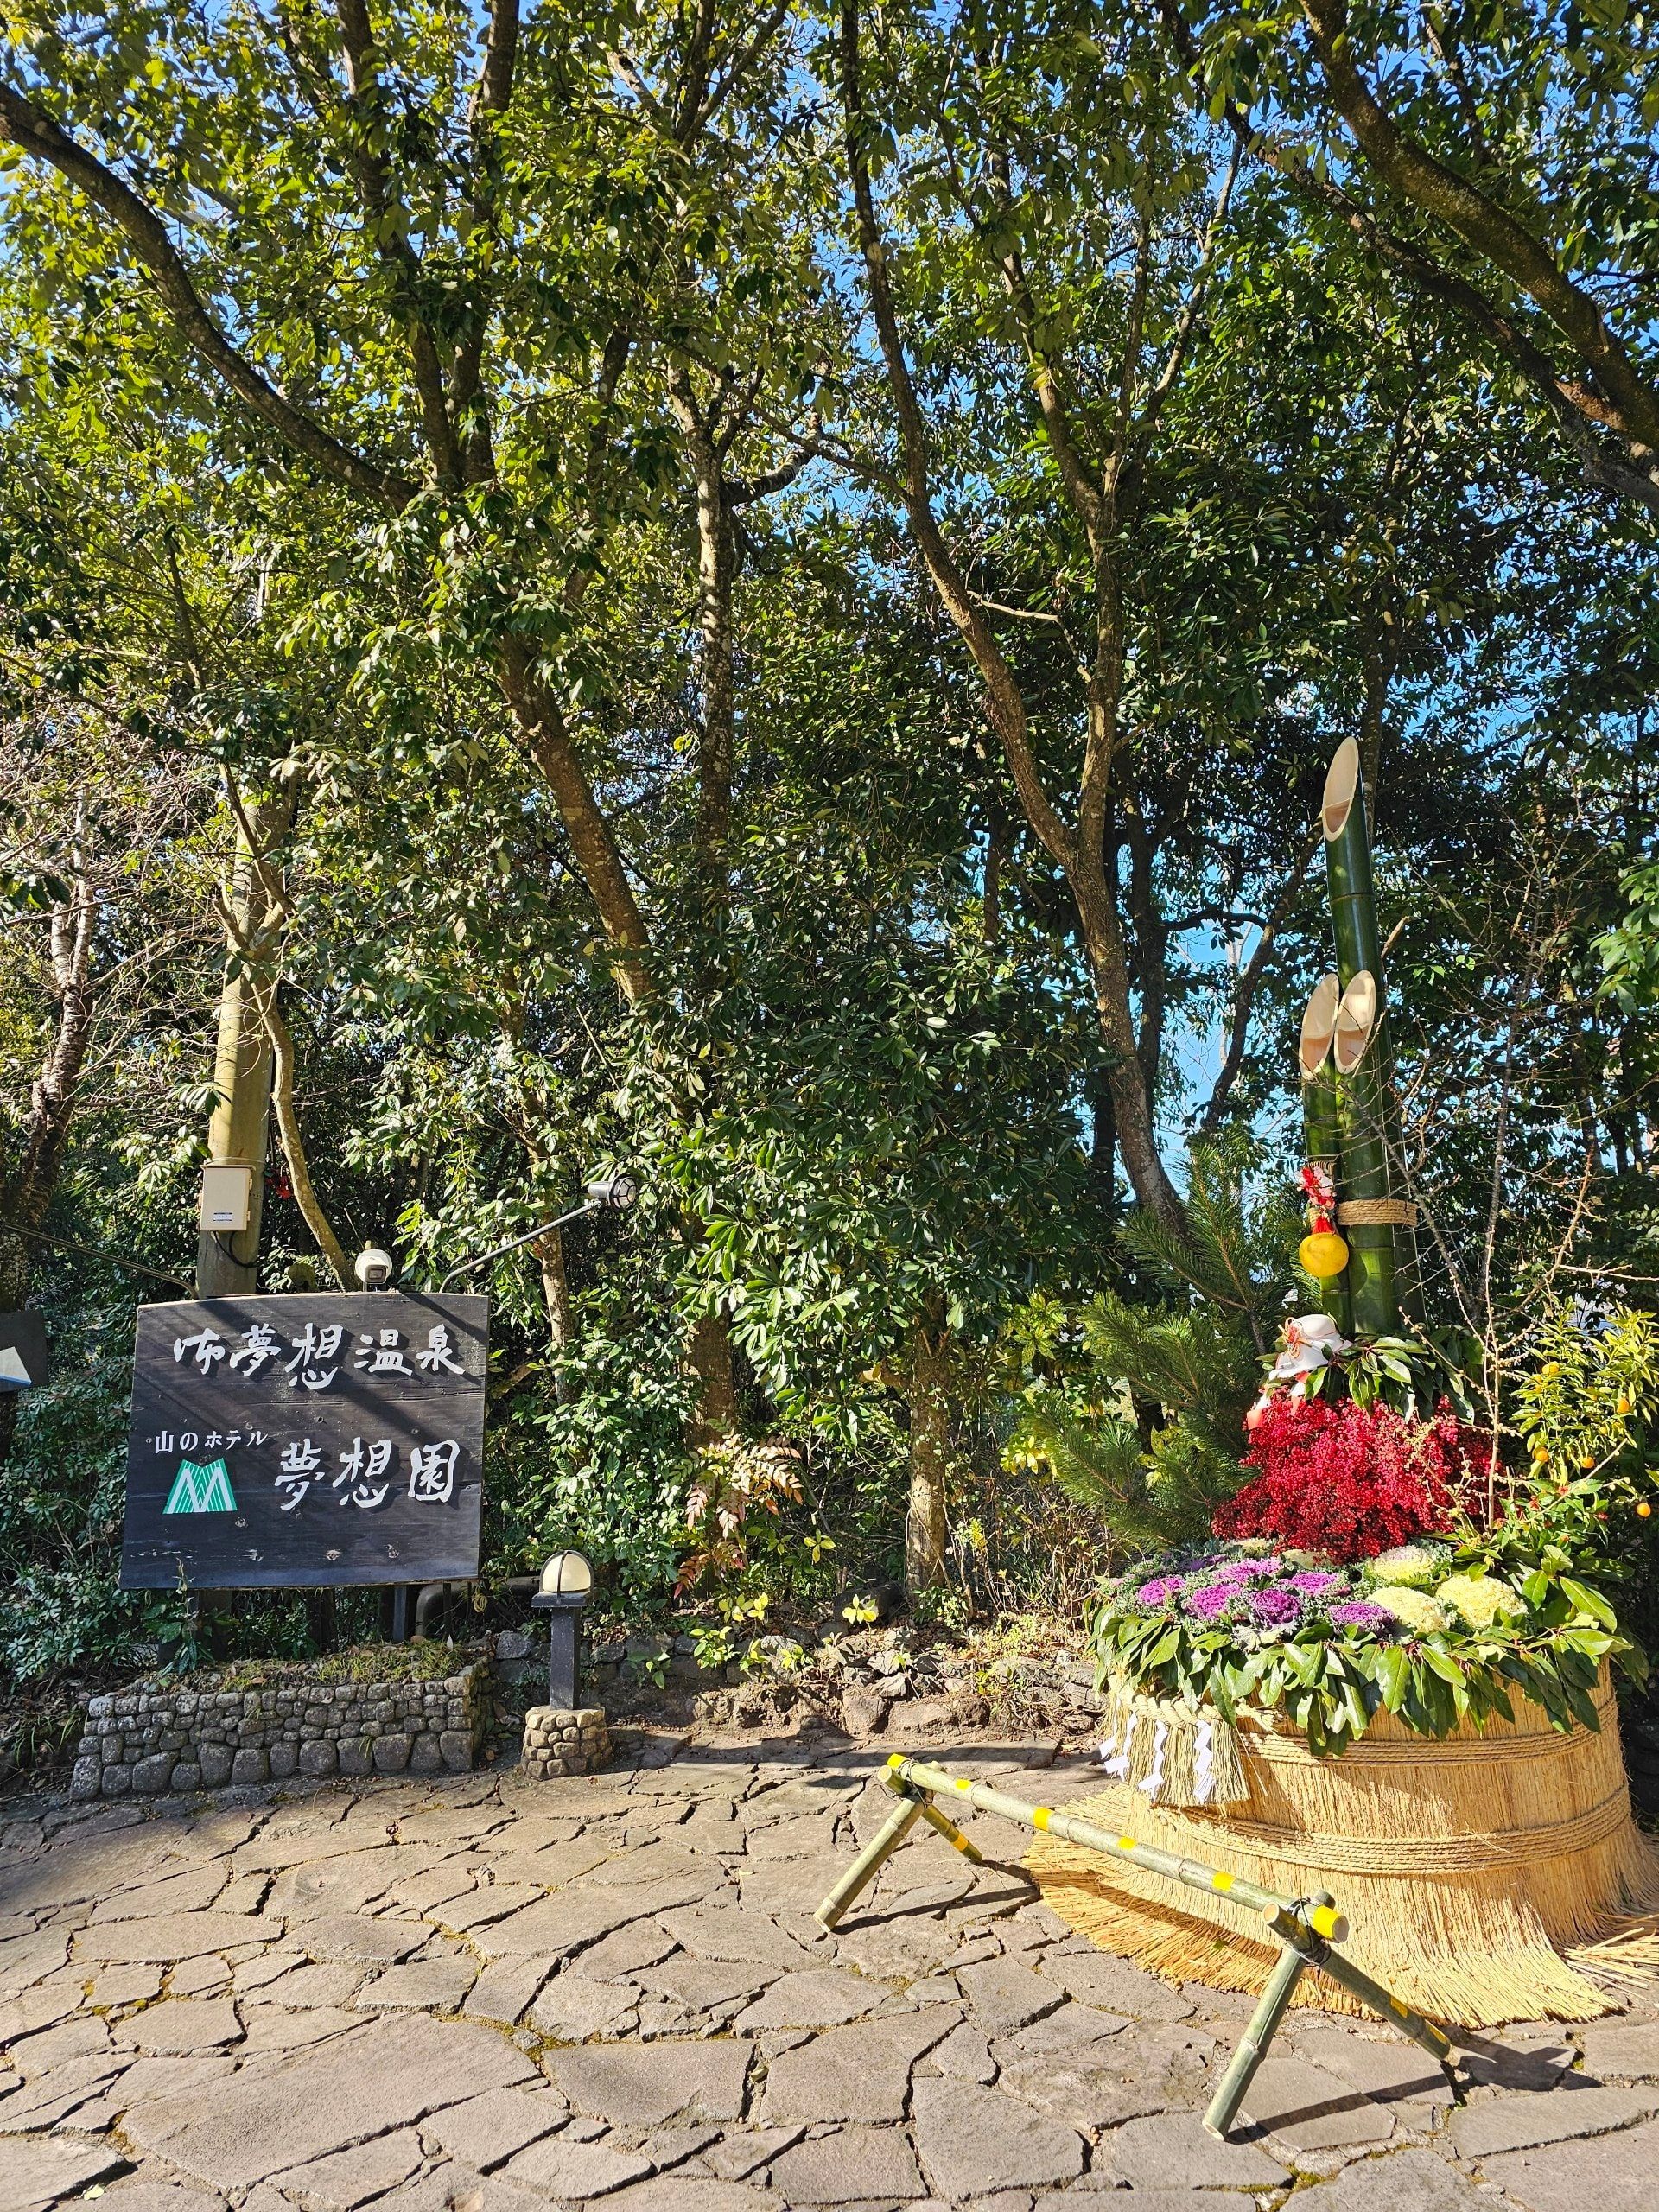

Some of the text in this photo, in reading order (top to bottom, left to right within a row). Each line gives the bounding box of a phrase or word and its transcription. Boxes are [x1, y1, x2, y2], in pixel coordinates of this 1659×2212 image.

[154, 1429, 269, 1454] 山のホテル
[274, 1436, 461, 1511] 夢想園
